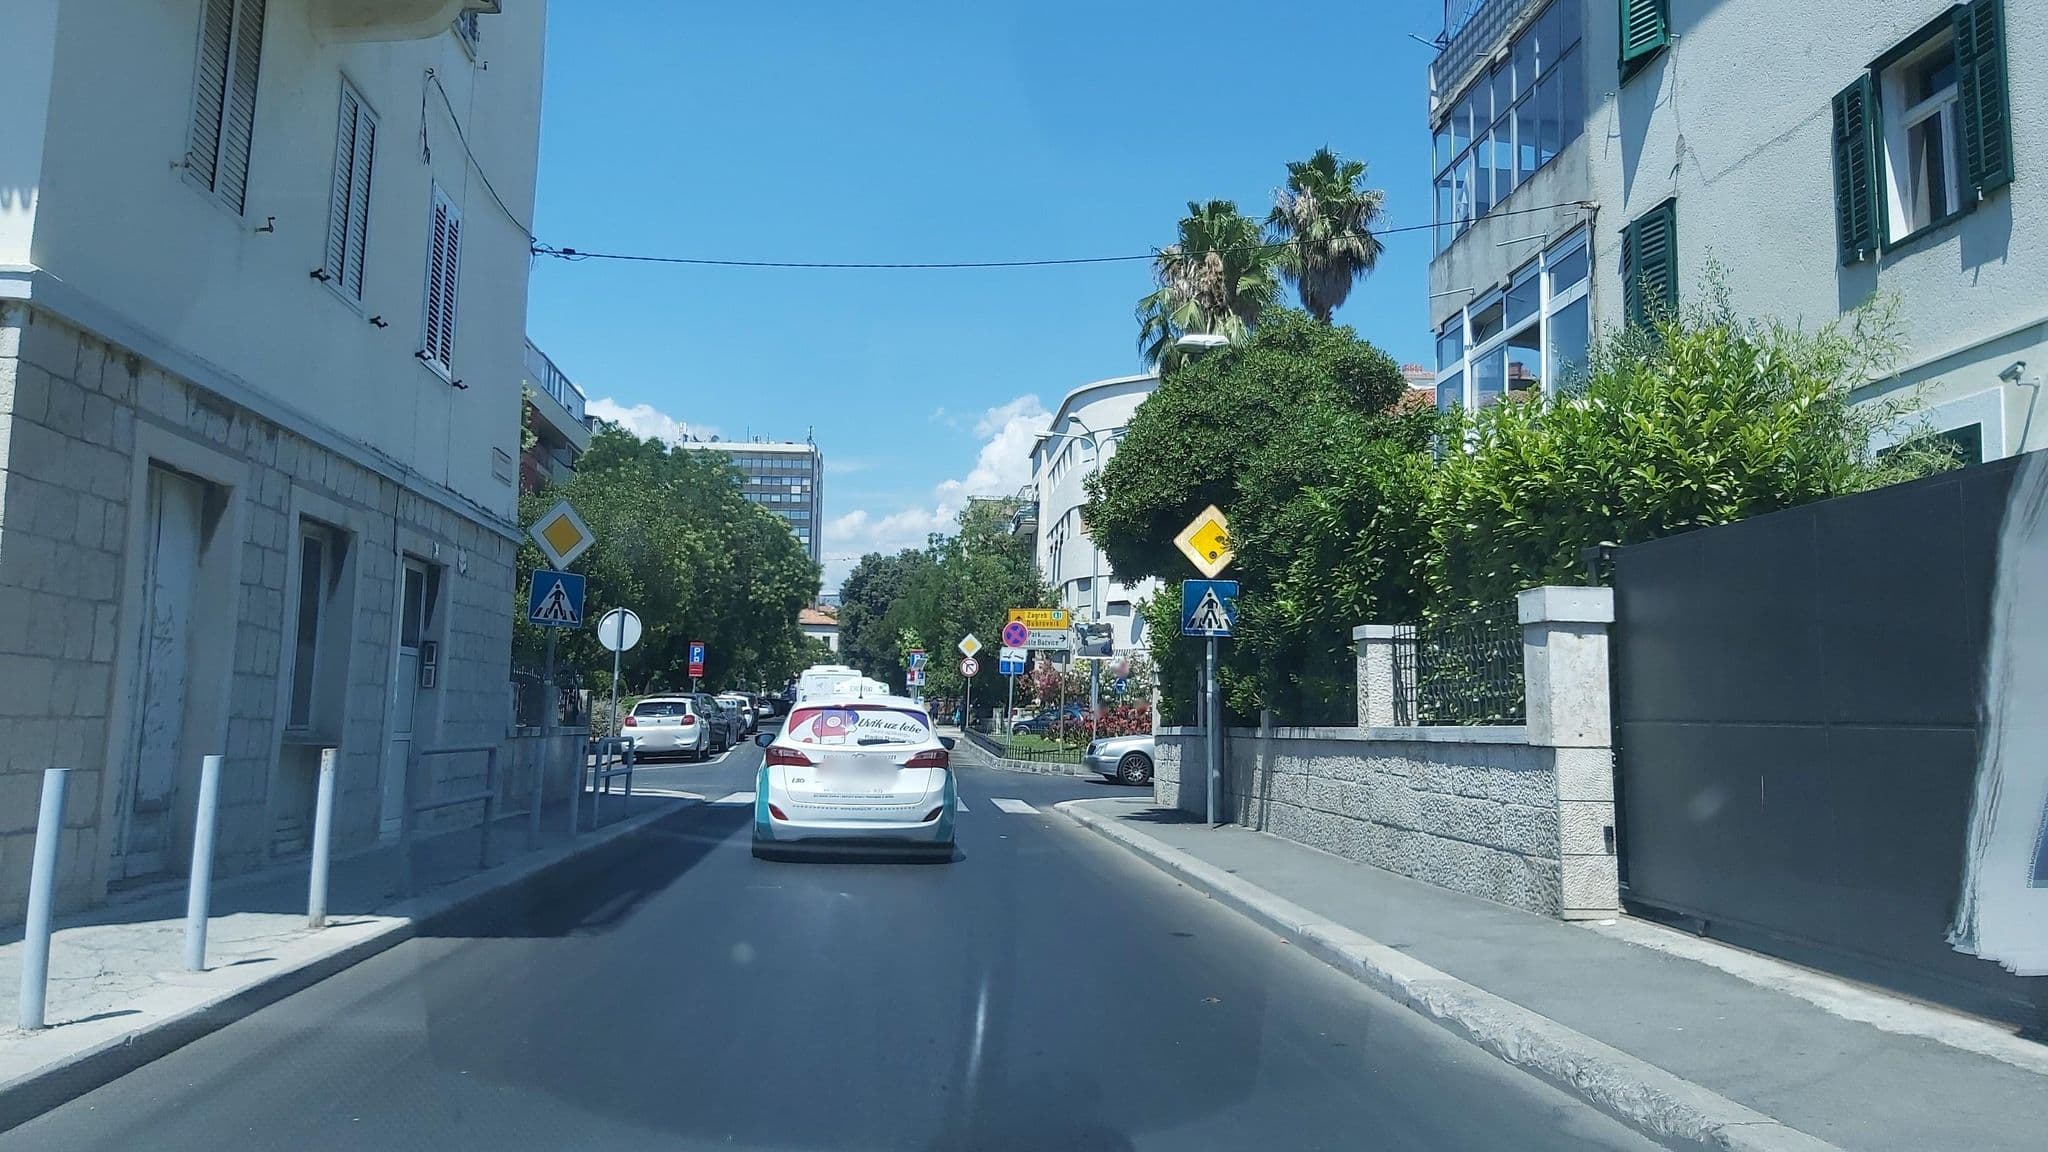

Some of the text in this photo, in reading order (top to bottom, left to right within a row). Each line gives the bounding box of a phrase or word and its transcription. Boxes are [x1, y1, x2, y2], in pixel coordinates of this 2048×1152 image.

[1027, 612, 1048, 620] Zagreb
[694, 647, 701, 656] P
[858, 718, 883, 729] Uvik
